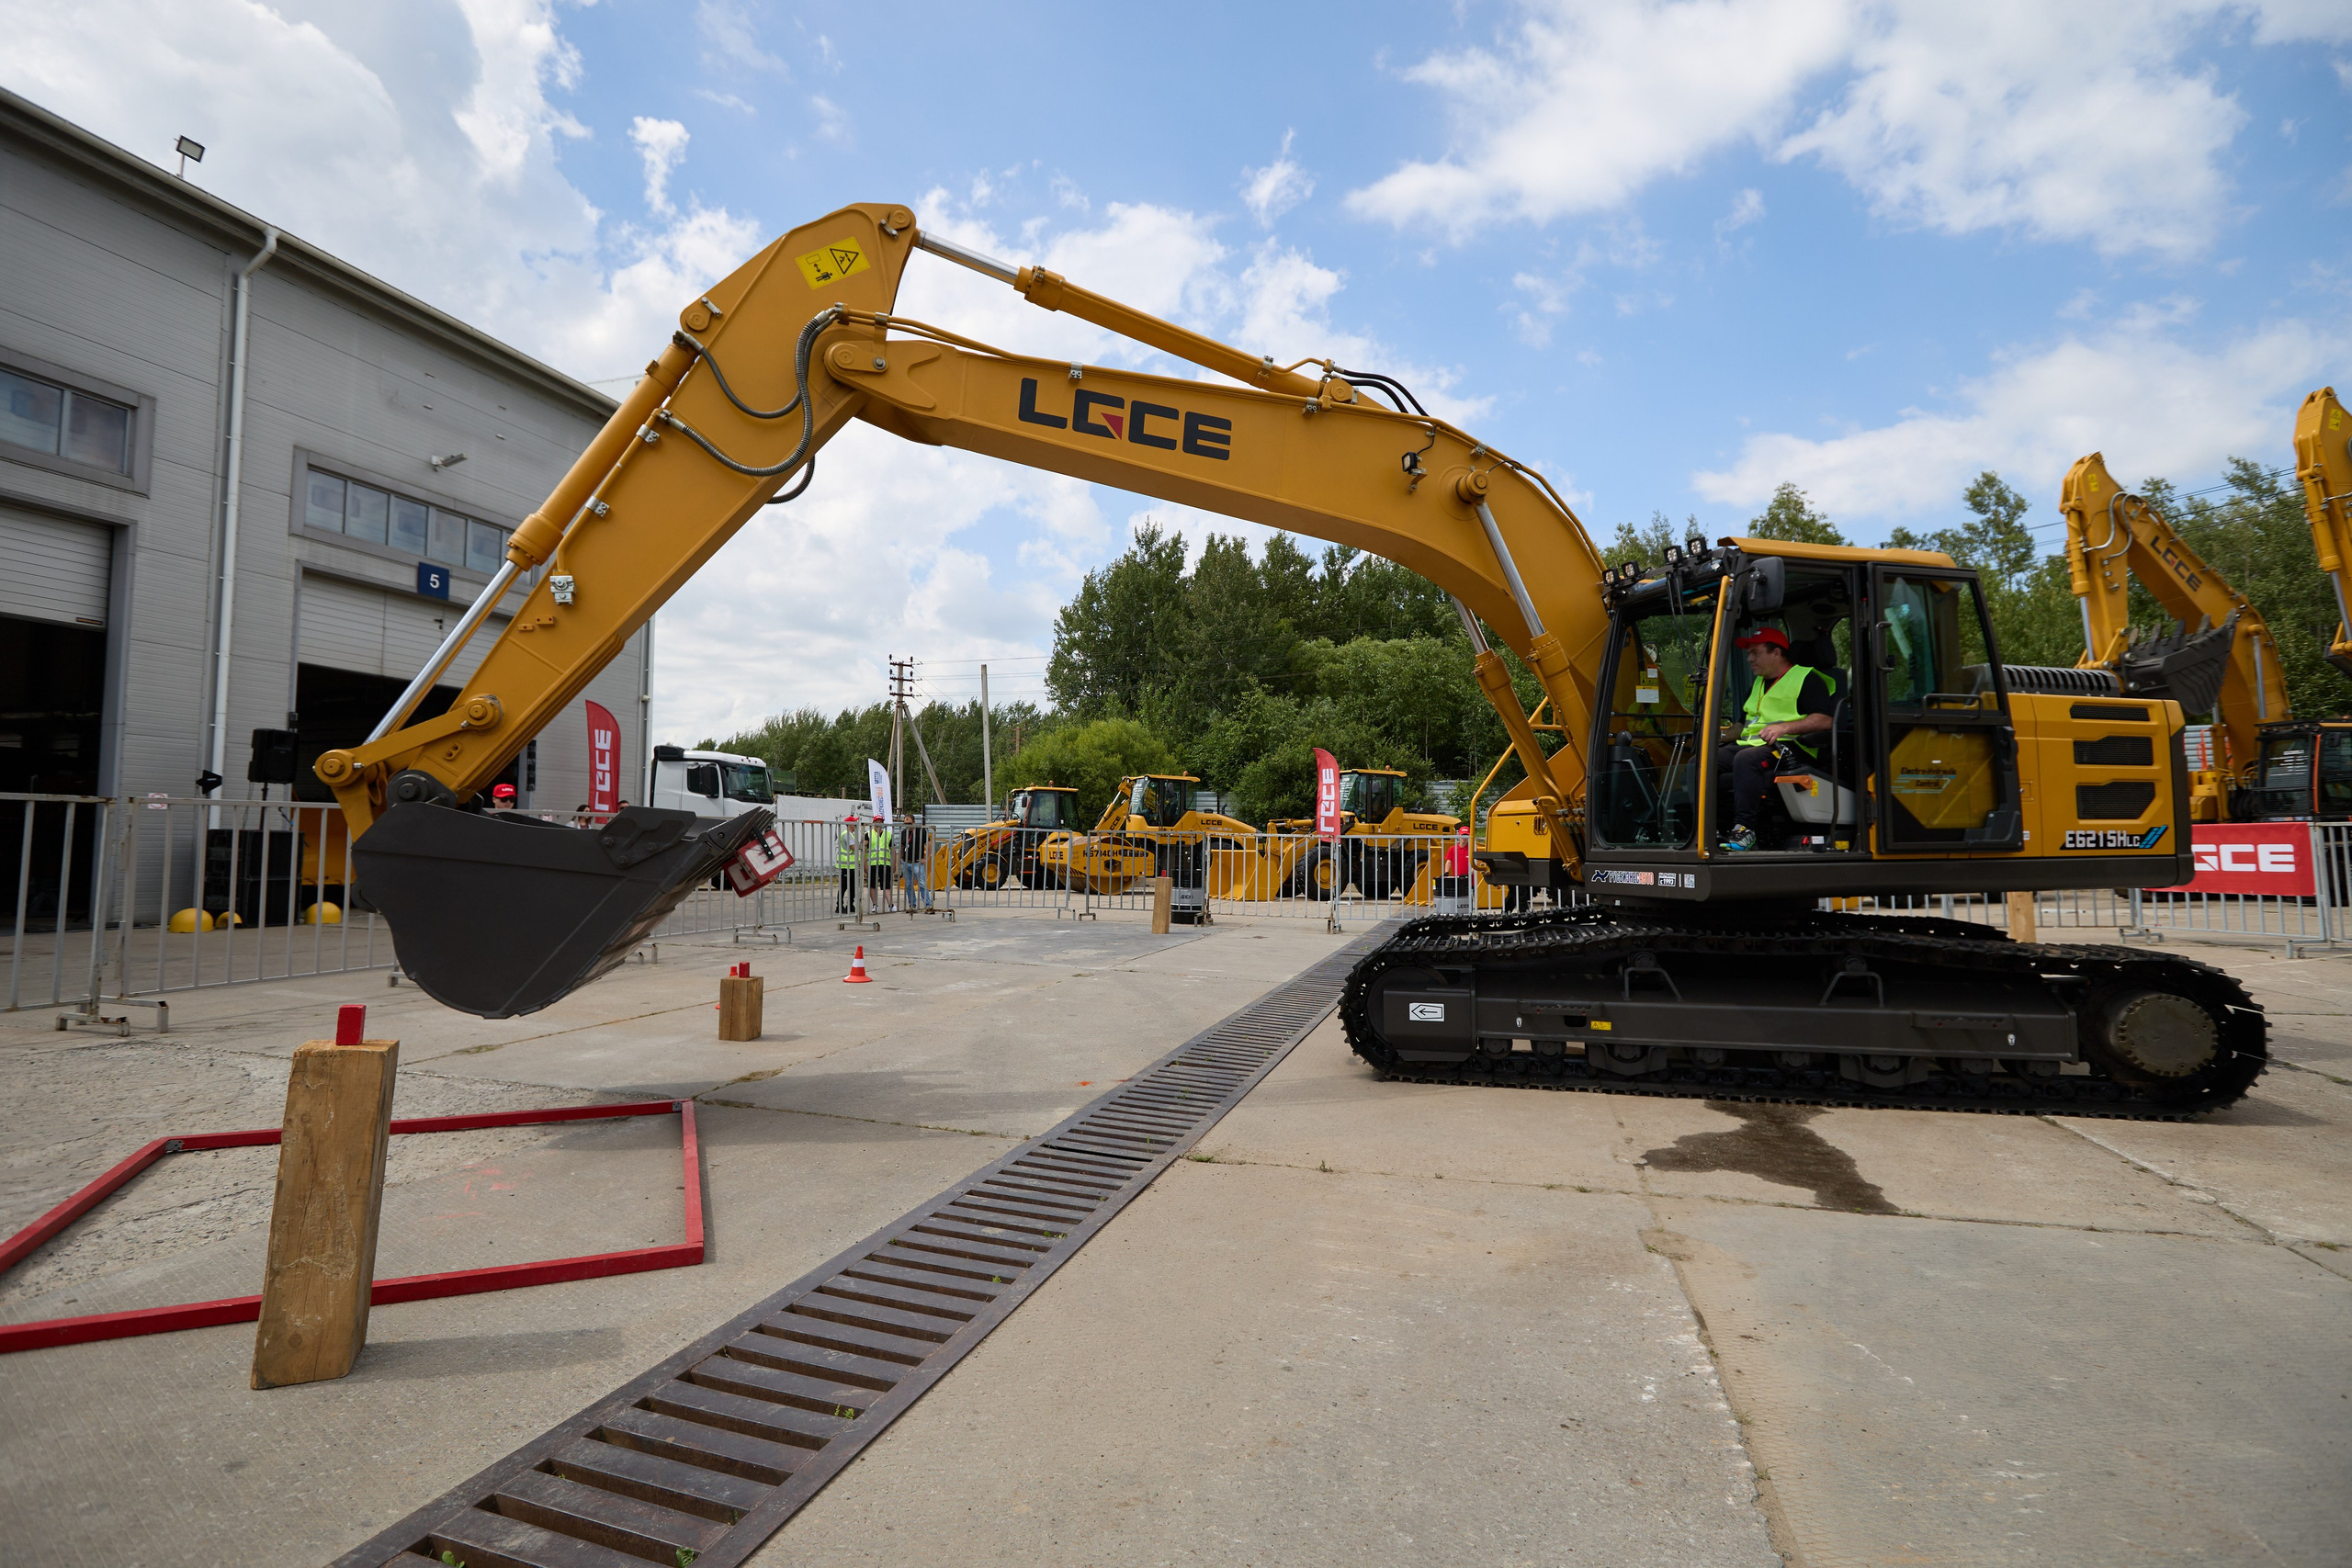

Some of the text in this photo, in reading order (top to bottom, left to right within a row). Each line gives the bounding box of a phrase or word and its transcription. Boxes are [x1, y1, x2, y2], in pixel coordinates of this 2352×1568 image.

[1018, 378, 1232, 460] LGCE
[429, 573, 440, 589] 5
[2151, 536, 2202, 592] LGCE
[594, 728, 612, 811] LGCE
[1109, 816, 1121, 830] GCE
[1320, 768, 1335, 832] LGCE
[2191, 843, 2296, 873] GCE
